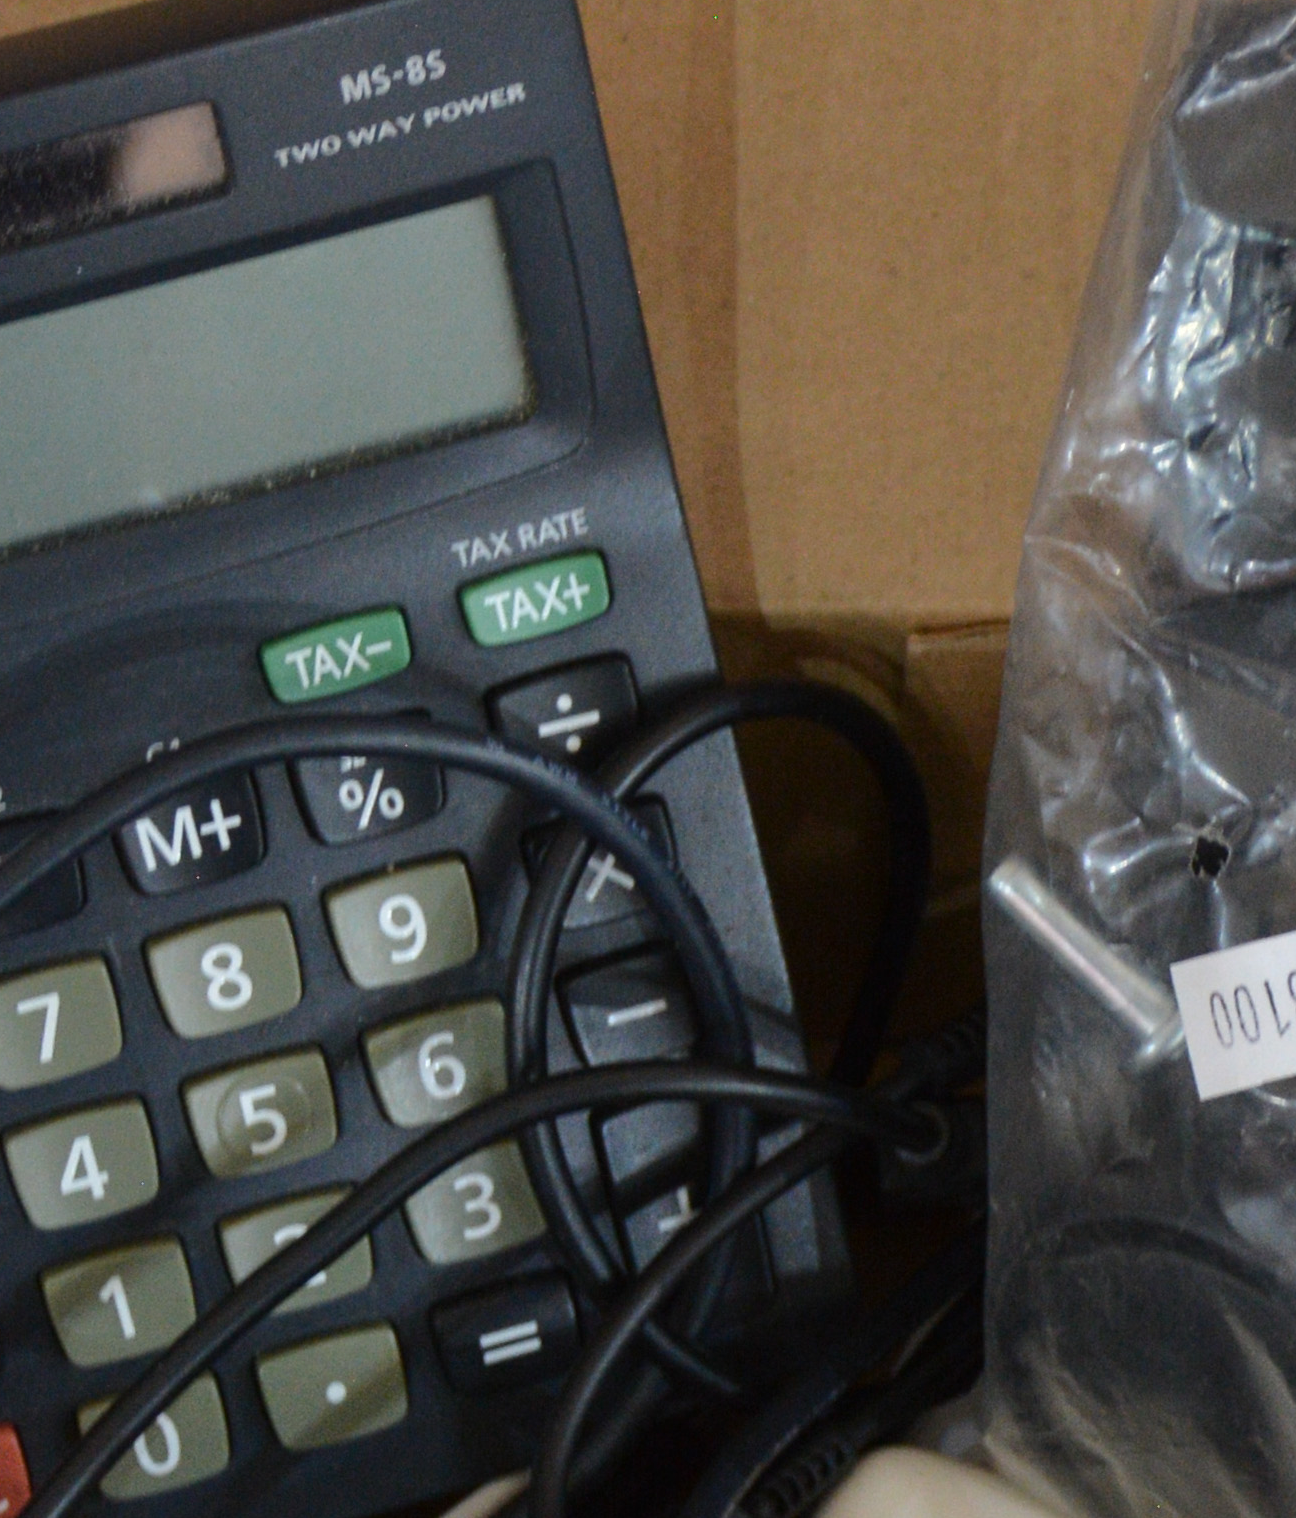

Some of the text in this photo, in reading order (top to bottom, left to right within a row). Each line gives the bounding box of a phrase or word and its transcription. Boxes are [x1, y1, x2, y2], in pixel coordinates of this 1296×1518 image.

[339, 48, 447, 105] MS-8S
[273, 81, 527, 168] TWO WAY POWER
[450, 507, 590, 568] TAX RATE
[483, 572, 591, 633] TAX+
[284, 631, 393, 690] TAX-
[338, 767, 405, 832] %
[135, 797, 242, 873] M+
[378, 893, 428, 964] 9
[201, 941, 254, 1012] 8
[16, 990, 61, 1065] 7
[417, 1030, 468, 1100] 6
[237, 1083, 288, 1157] 5
[59, 1134, 109, 1201] 4
[454, 1171, 502, 1241] 3
[99, 1274, 136, 1340] 1
[133, 1412, 181, 1478] 0
